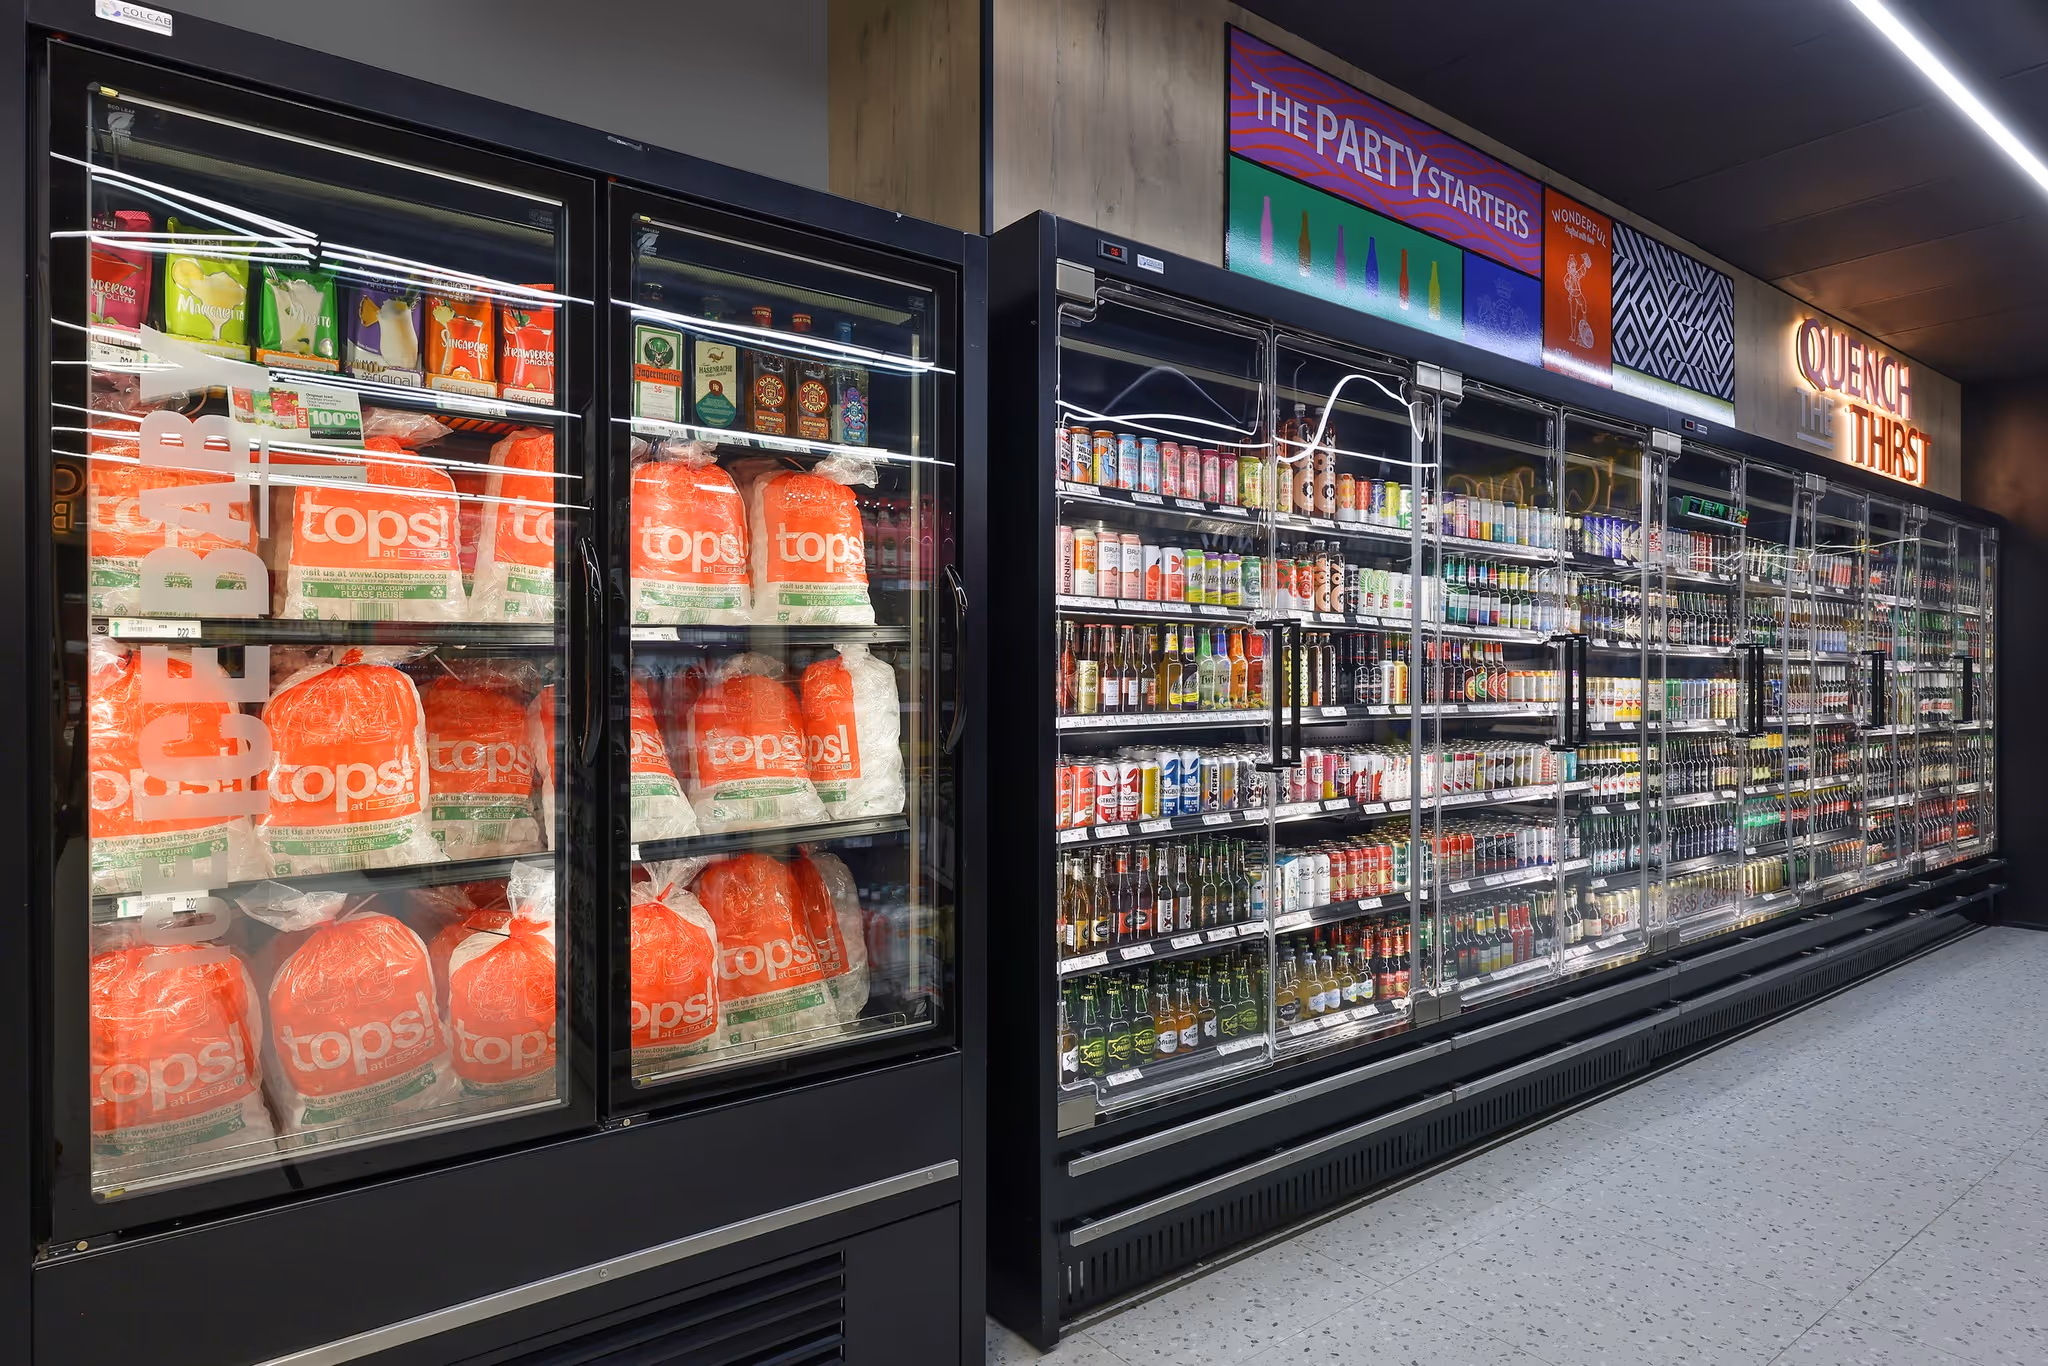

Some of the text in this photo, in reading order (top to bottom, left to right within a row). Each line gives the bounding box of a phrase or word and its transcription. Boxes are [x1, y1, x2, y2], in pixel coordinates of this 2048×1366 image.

[122, 6, 172, 26] COLCAB
[1251, 80, 1530, 240] THE PARTY STARTERS
[1551, 208, 1607, 249] WONDERFUL
[440, 329, 489, 353] SINGAPORE
[1796, 318, 1913, 421] QUENCH
[758, 376, 782, 390] OLMECA
[802, 382, 824, 396] OLMECA
[758, 393, 783, 407] TEQUILA
[801, 400, 826, 412] TEQUILA
[298, 415, 307, 423] 3
[1796, 386, 1835, 440] THE
[1848, 403, 1932, 485] THIRST
[139, 322, 270, 618] BABY
[300, 490, 450, 558] tops!
[638, 516, 746, 573] tops!
[383, 548, 396, 559] at
[300, 568, 320, 577] visit
[337, 569, 347, 578] at
[348, 570, 448, 581] www.topsatspar.co.za
[1063, 555, 1071, 594] BERNINI
[340, 590, 404, 599] PLEASE REUSE
[139, 644, 273, 822] ICE
[268, 744, 415, 813] tops!
[350, 801, 364, 811] at
[268, 826, 290, 836] visit
[290, 827, 304, 836] us
[304, 826, 316, 835] at
[301, 835, 388, 848] WE LOVE OUR COUNTRY
[155, 845, 194, 858] COUNTRY
[309, 843, 375, 855] PLEASE REUSE
[777, 971, 788, 979] at
[723, 1000, 738, 1009] visit
[738, 999, 749, 1007] us
[749, 997, 758, 1006] at
[279, 990, 435, 1076] tops!
[661, 1030, 672, 1038] at
[370, 1061, 385, 1072] at
[169, 1095, 184, 1107] at
